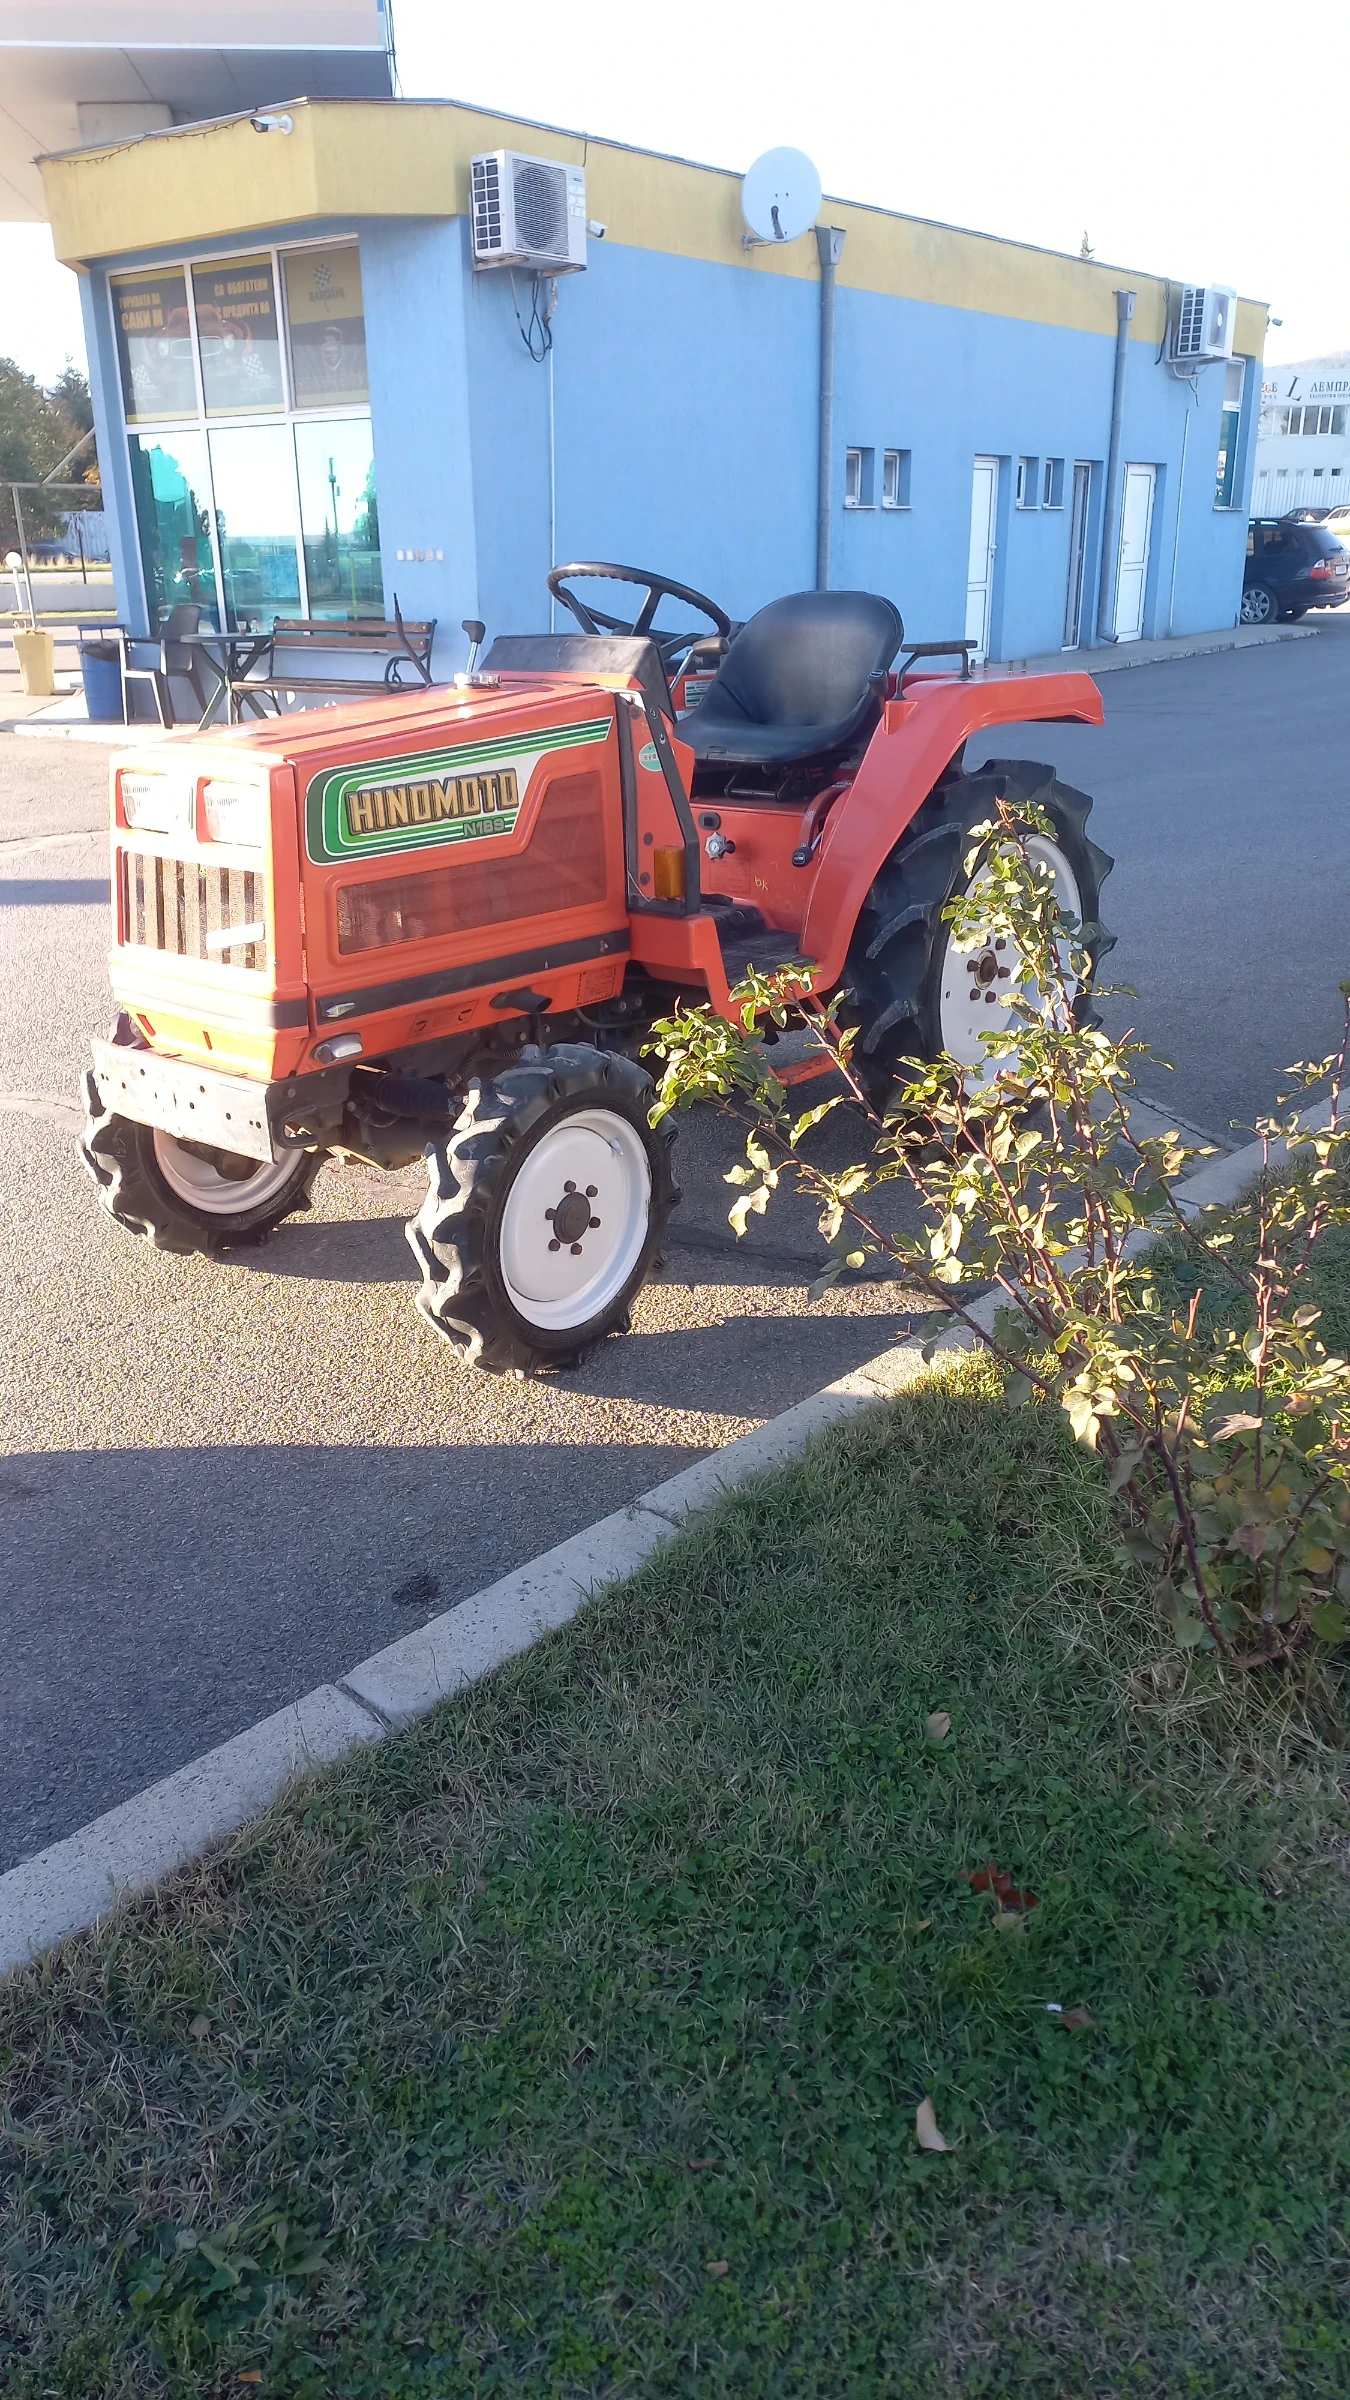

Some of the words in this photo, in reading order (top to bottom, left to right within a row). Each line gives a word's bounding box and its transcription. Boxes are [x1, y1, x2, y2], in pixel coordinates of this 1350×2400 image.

[214, 284, 225, 297] СА
[227, 278, 268, 295] ОБОГАТЕНИ
[259, 300, 271, 315] НА
[121, 310, 151, 330] САКИ
[152, 308, 164, 327] М
[344, 767, 520, 836] HINOMOTO
[462, 818, 505, 837] N189
